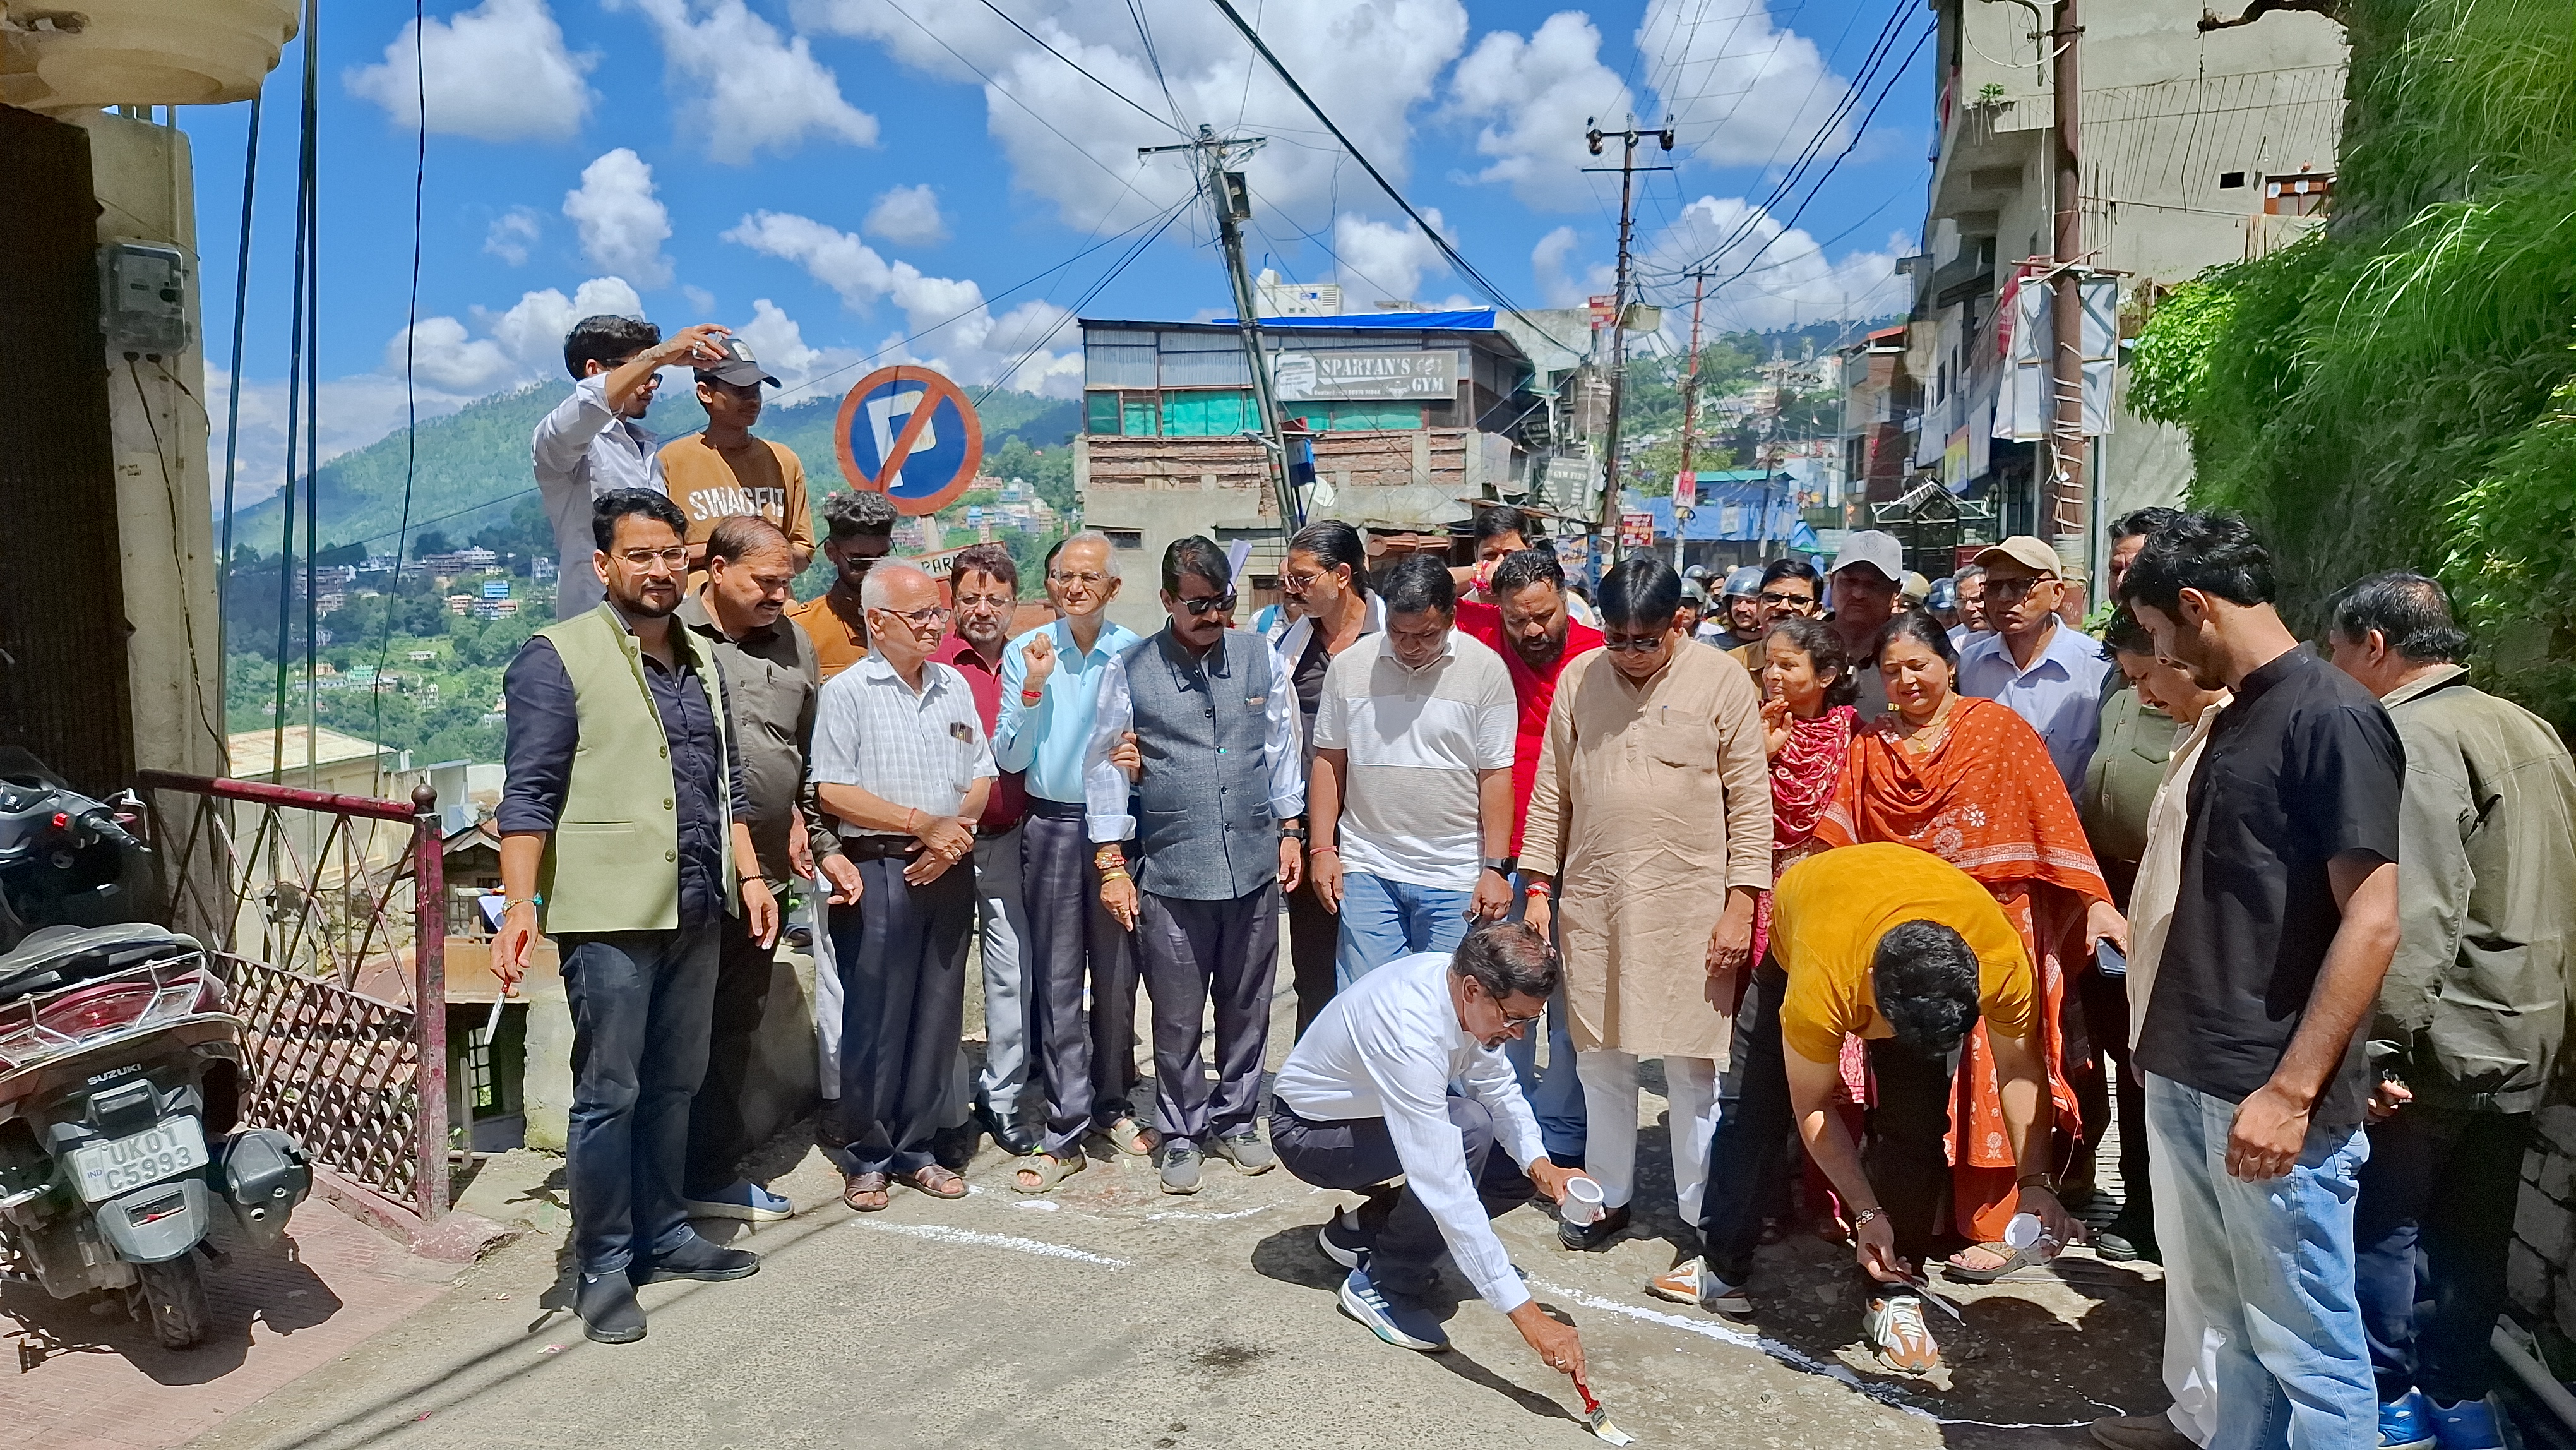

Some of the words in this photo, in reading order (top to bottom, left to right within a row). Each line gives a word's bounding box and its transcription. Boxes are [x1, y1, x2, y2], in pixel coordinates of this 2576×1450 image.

[1321, 358, 1411, 376] SPARTAN'S
[1412, 377, 1444, 392] GYM
[921, 556, 957, 573] PAR
[87, 1063, 142, 1086] SUZUKI
[110, 1126, 178, 1165] UK01
[87, 1169, 103, 1179] IND
[106, 1146, 191, 1191] C5993
